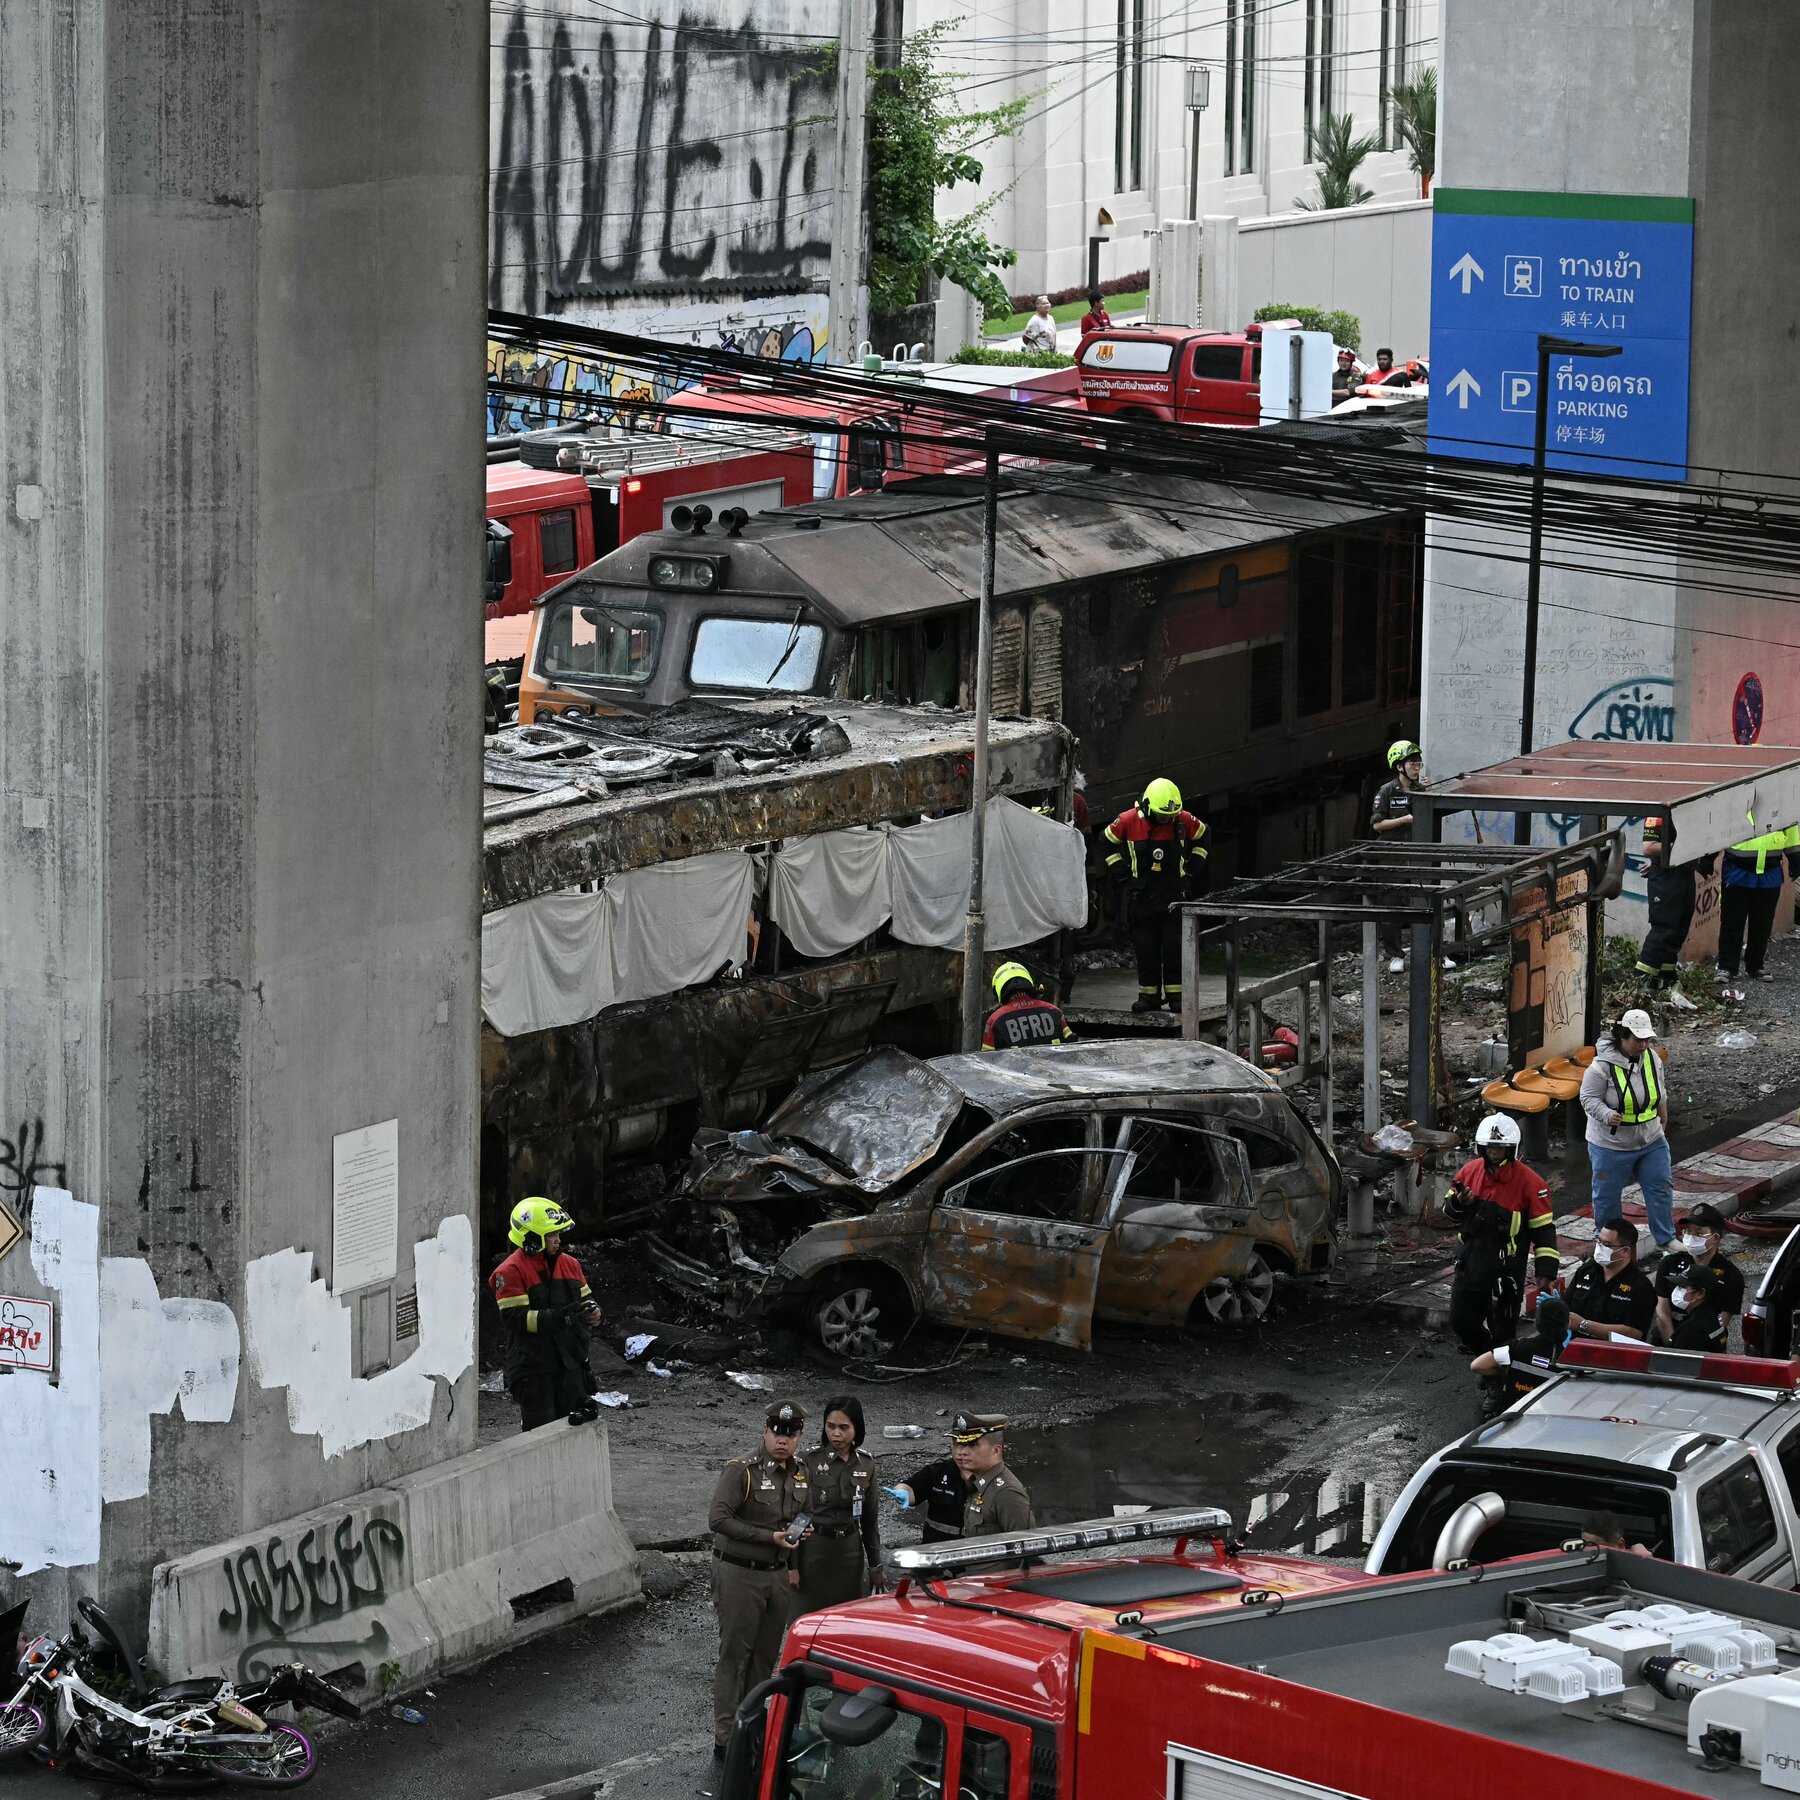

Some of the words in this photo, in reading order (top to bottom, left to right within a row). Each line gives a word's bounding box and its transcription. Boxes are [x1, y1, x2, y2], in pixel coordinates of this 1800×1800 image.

[1559, 251, 1641, 279] ทางเข้า
[1560, 285, 1580, 301] TO
[1585, 286, 1634, 304] TRAIN
[1560, 311, 1626, 329] 乘车入口
[1556, 358, 1651, 395] ที่จอดรถ
[1511, 378, 1531, 405] P
[1557, 400, 1628, 418] PARKING
[1556, 425, 1605, 444] 停车场
[1005, 1013, 1055, 1043] BFRD
